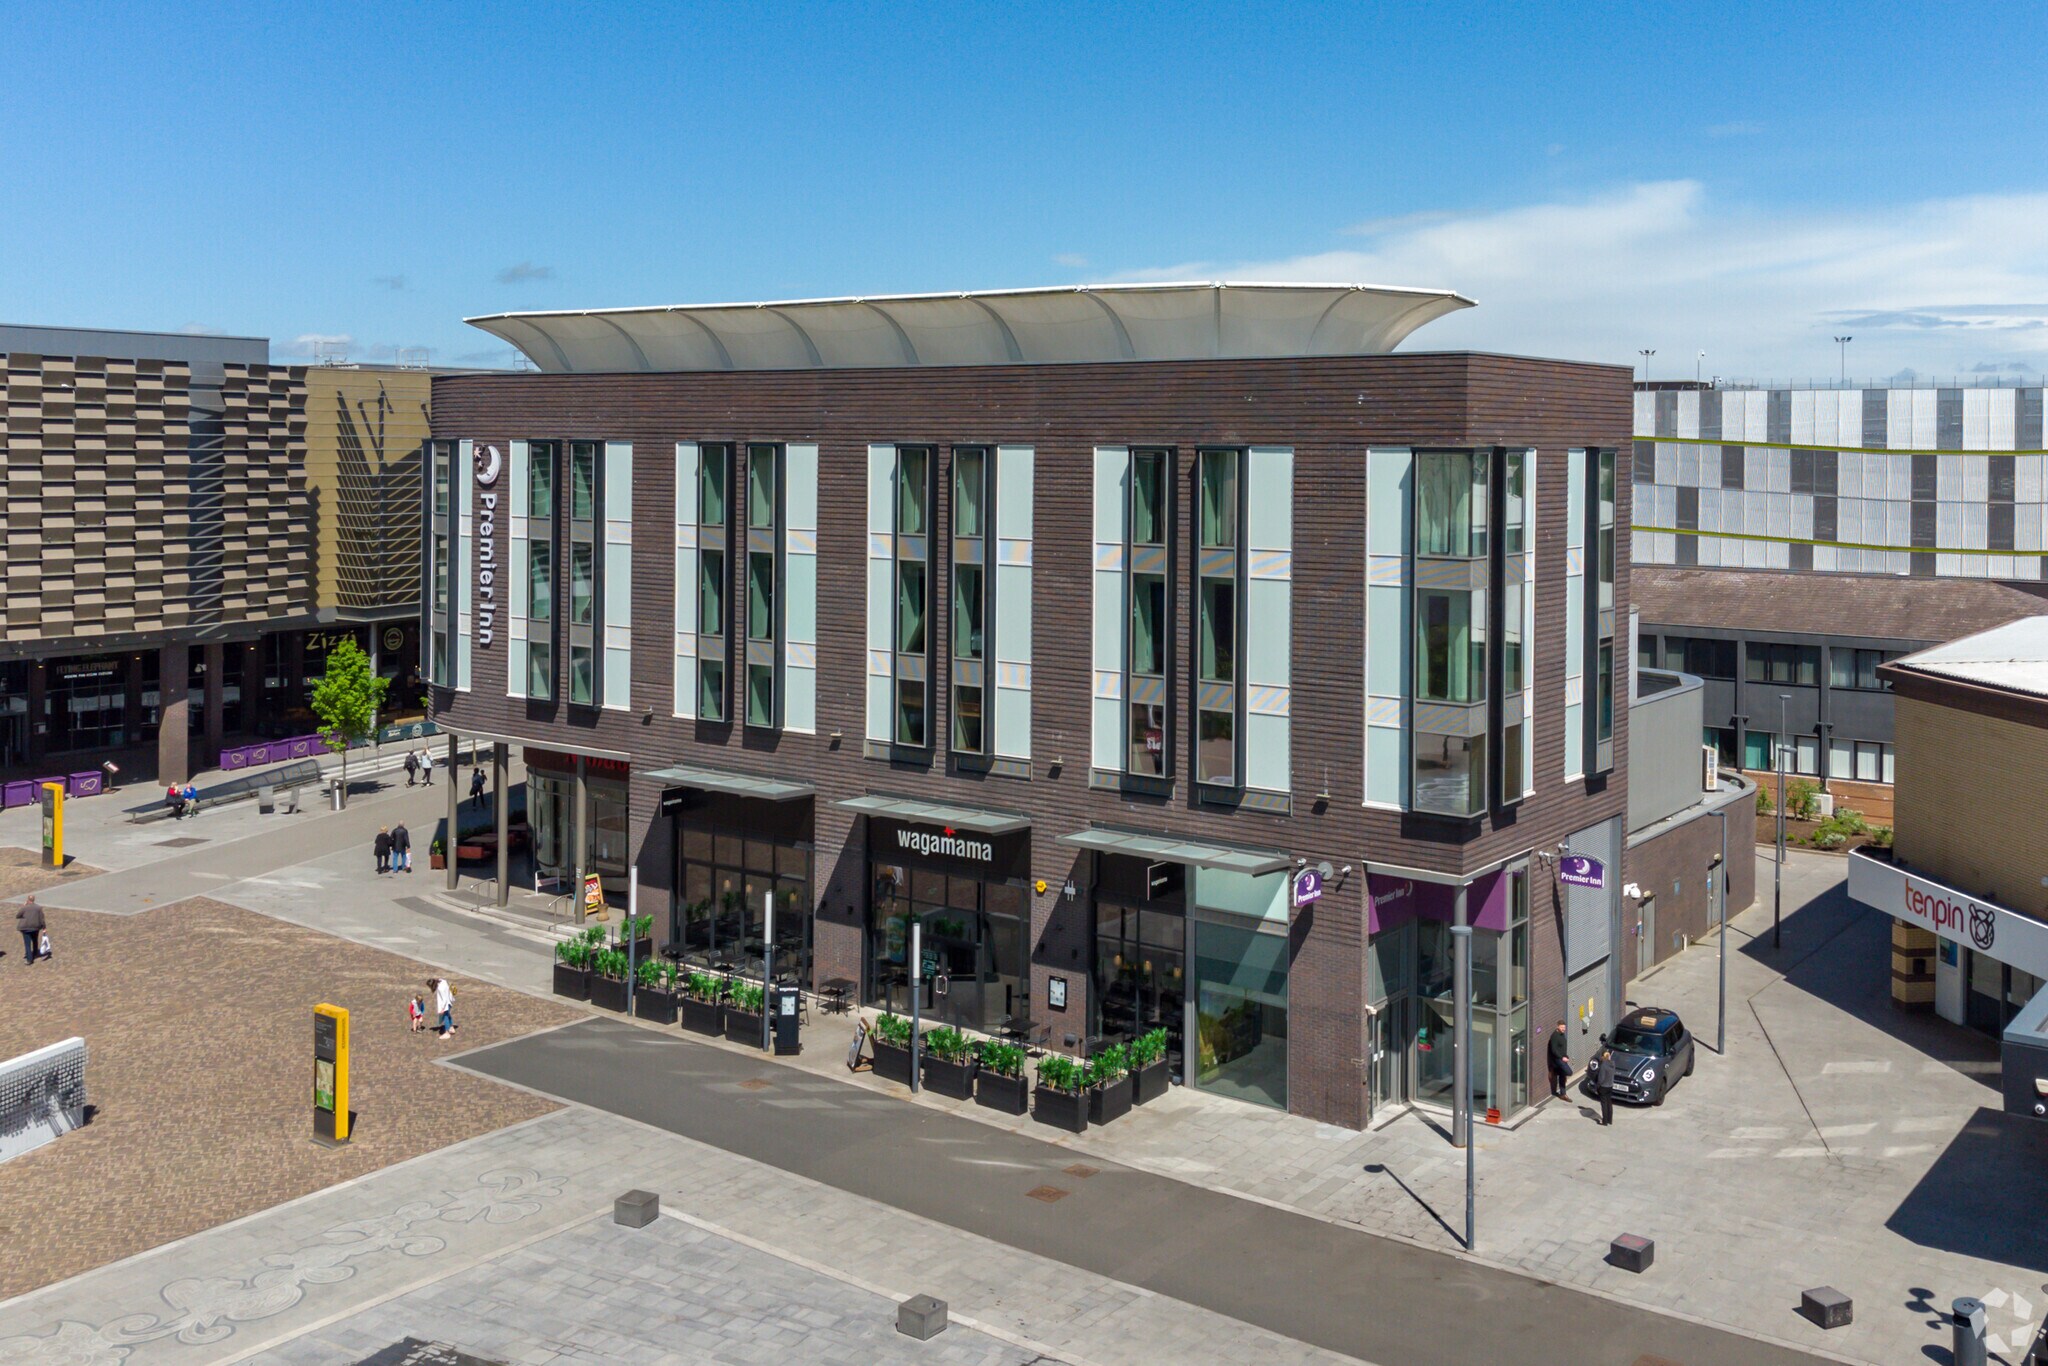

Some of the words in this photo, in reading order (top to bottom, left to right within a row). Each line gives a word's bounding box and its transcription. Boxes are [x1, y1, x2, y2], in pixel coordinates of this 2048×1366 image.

[480, 493, 498, 599] Premier
[480, 603, 497, 645] Inn
[897, 829, 993, 861] wagamama
[1561, 871, 1589, 884] Premier
[1590, 876, 1602, 886] Inn
[1298, 891, 1314, 903] Premier
[1314, 889, 1322, 898] Inn
[1374, 891, 1396, 907] Premier
[1396, 888, 1405, 899] Inn
[1905, 878, 1964, 933] tenpin
